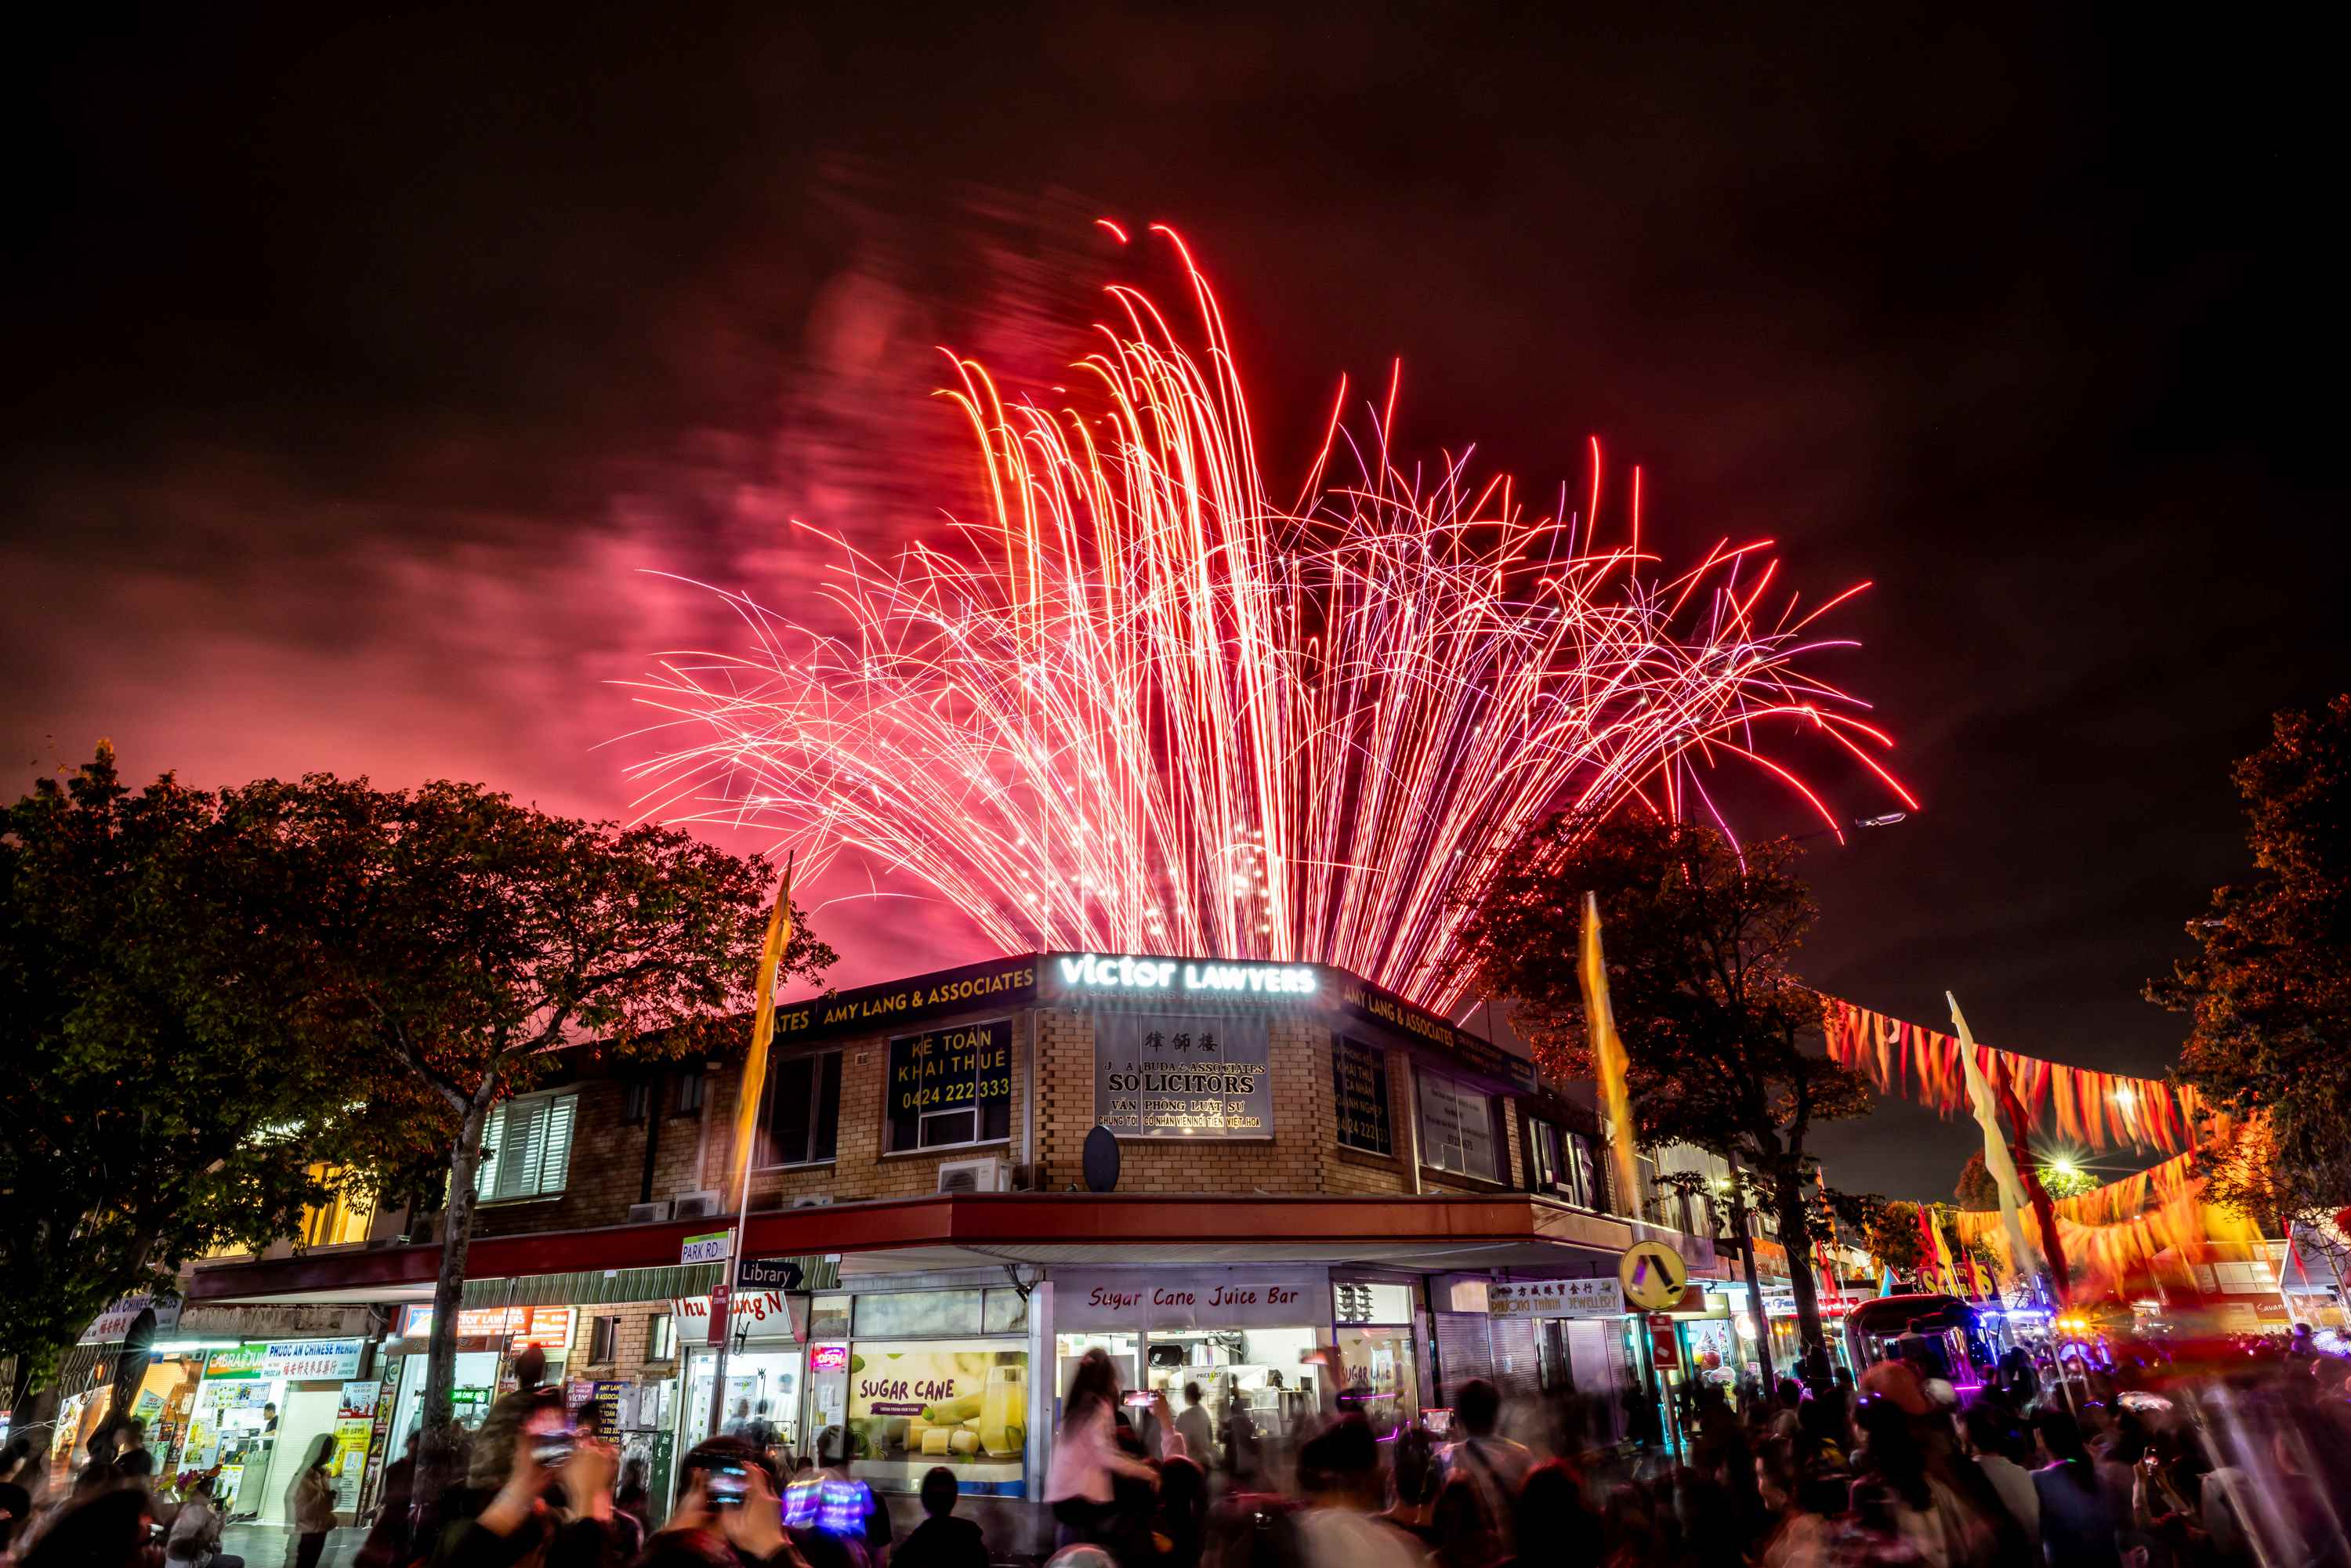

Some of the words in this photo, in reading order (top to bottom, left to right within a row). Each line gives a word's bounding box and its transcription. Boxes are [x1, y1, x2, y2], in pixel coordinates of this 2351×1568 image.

[1060, 954, 1176, 987] victor
[1185, 964, 1317, 993] LAWYERS
[824, 1002, 858, 1025] AMY
[863, 994, 907, 1016] LANG
[912, 990, 923, 1008] &
[928, 969, 1034, 1005] ASSOCIATES
[1343, 986, 1365, 1009] AMY
[1368, 995, 1394, 1022] LANG
[1397, 1009, 1404, 1025] &
[1405, 1013, 1454, 1047] ASSOCIATES
[943, 1027, 991, 1052] TOÁN
[899, 1059, 944, 1082] KHAI
[1143, 1061, 1176, 1072] BUDA
[1178, 1063, 1188, 1072] &
[1190, 1062, 1266, 1074] ASSOCIATES
[903, 1086, 940, 1109] 0424
[945, 1082, 974, 1102] 222
[980, 1078, 1009, 1098] 333
[1109, 1074, 1255, 1094] SOLICITORS
[683, 1243, 704, 1261] PARK
[706, 1242, 719, 1258] RD
[741, 1264, 791, 1287] Library
[672, 1297, 708, 1317] Thu
[1088, 1287, 1142, 1310] Sugar
[1153, 1287, 1196, 1305] Cane
[1208, 1286, 1257, 1306] Juice
[1266, 1287, 1299, 1305] Bar
[293, 1344, 304, 1356] AN
[304, 1342, 334, 1356] CHINESE
[817, 1353, 842, 1364] OPEN
[209, 1353, 241, 1368] CABRA
[1342, 1363, 1369, 1385] SUGAR
[860, 1379, 909, 1400] SUGAR
[915, 1379, 955, 1401] CANE
